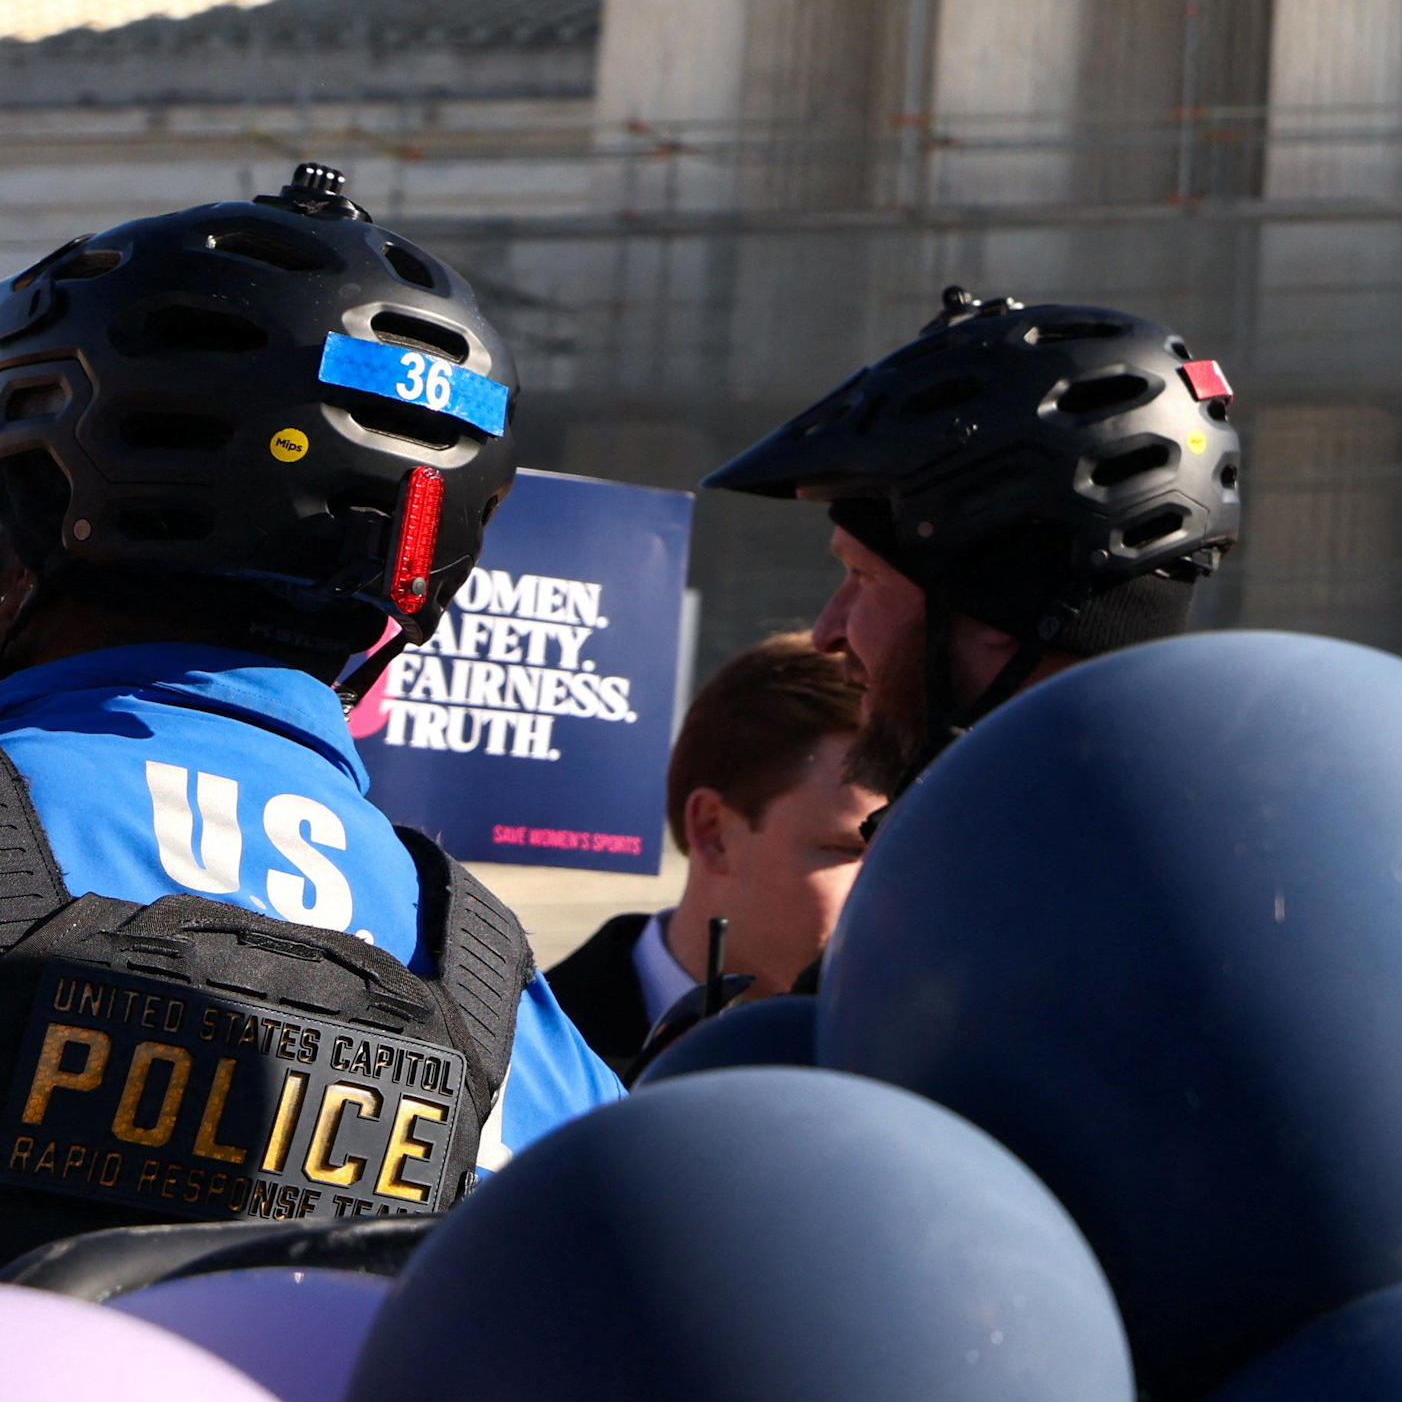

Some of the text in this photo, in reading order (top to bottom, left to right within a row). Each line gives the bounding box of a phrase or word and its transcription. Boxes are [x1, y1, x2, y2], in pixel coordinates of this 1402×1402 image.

[396, 351, 453, 411] 36
[276, 438, 303, 452] Mips
[453, 566, 609, 629] OMEN.
[404, 609, 596, 672] AFETY.
[384, 652, 638, 724] FAIRNESS.
[379, 698, 561, 762] TRUTH.
[53, 977, 455, 1097] UNITED STATES CAPITOL
[21, 1022, 450, 1204] POLICE
[9, 1135, 123, 1187] RAPID
[137, 1159, 322, 1220] RESPONSE
